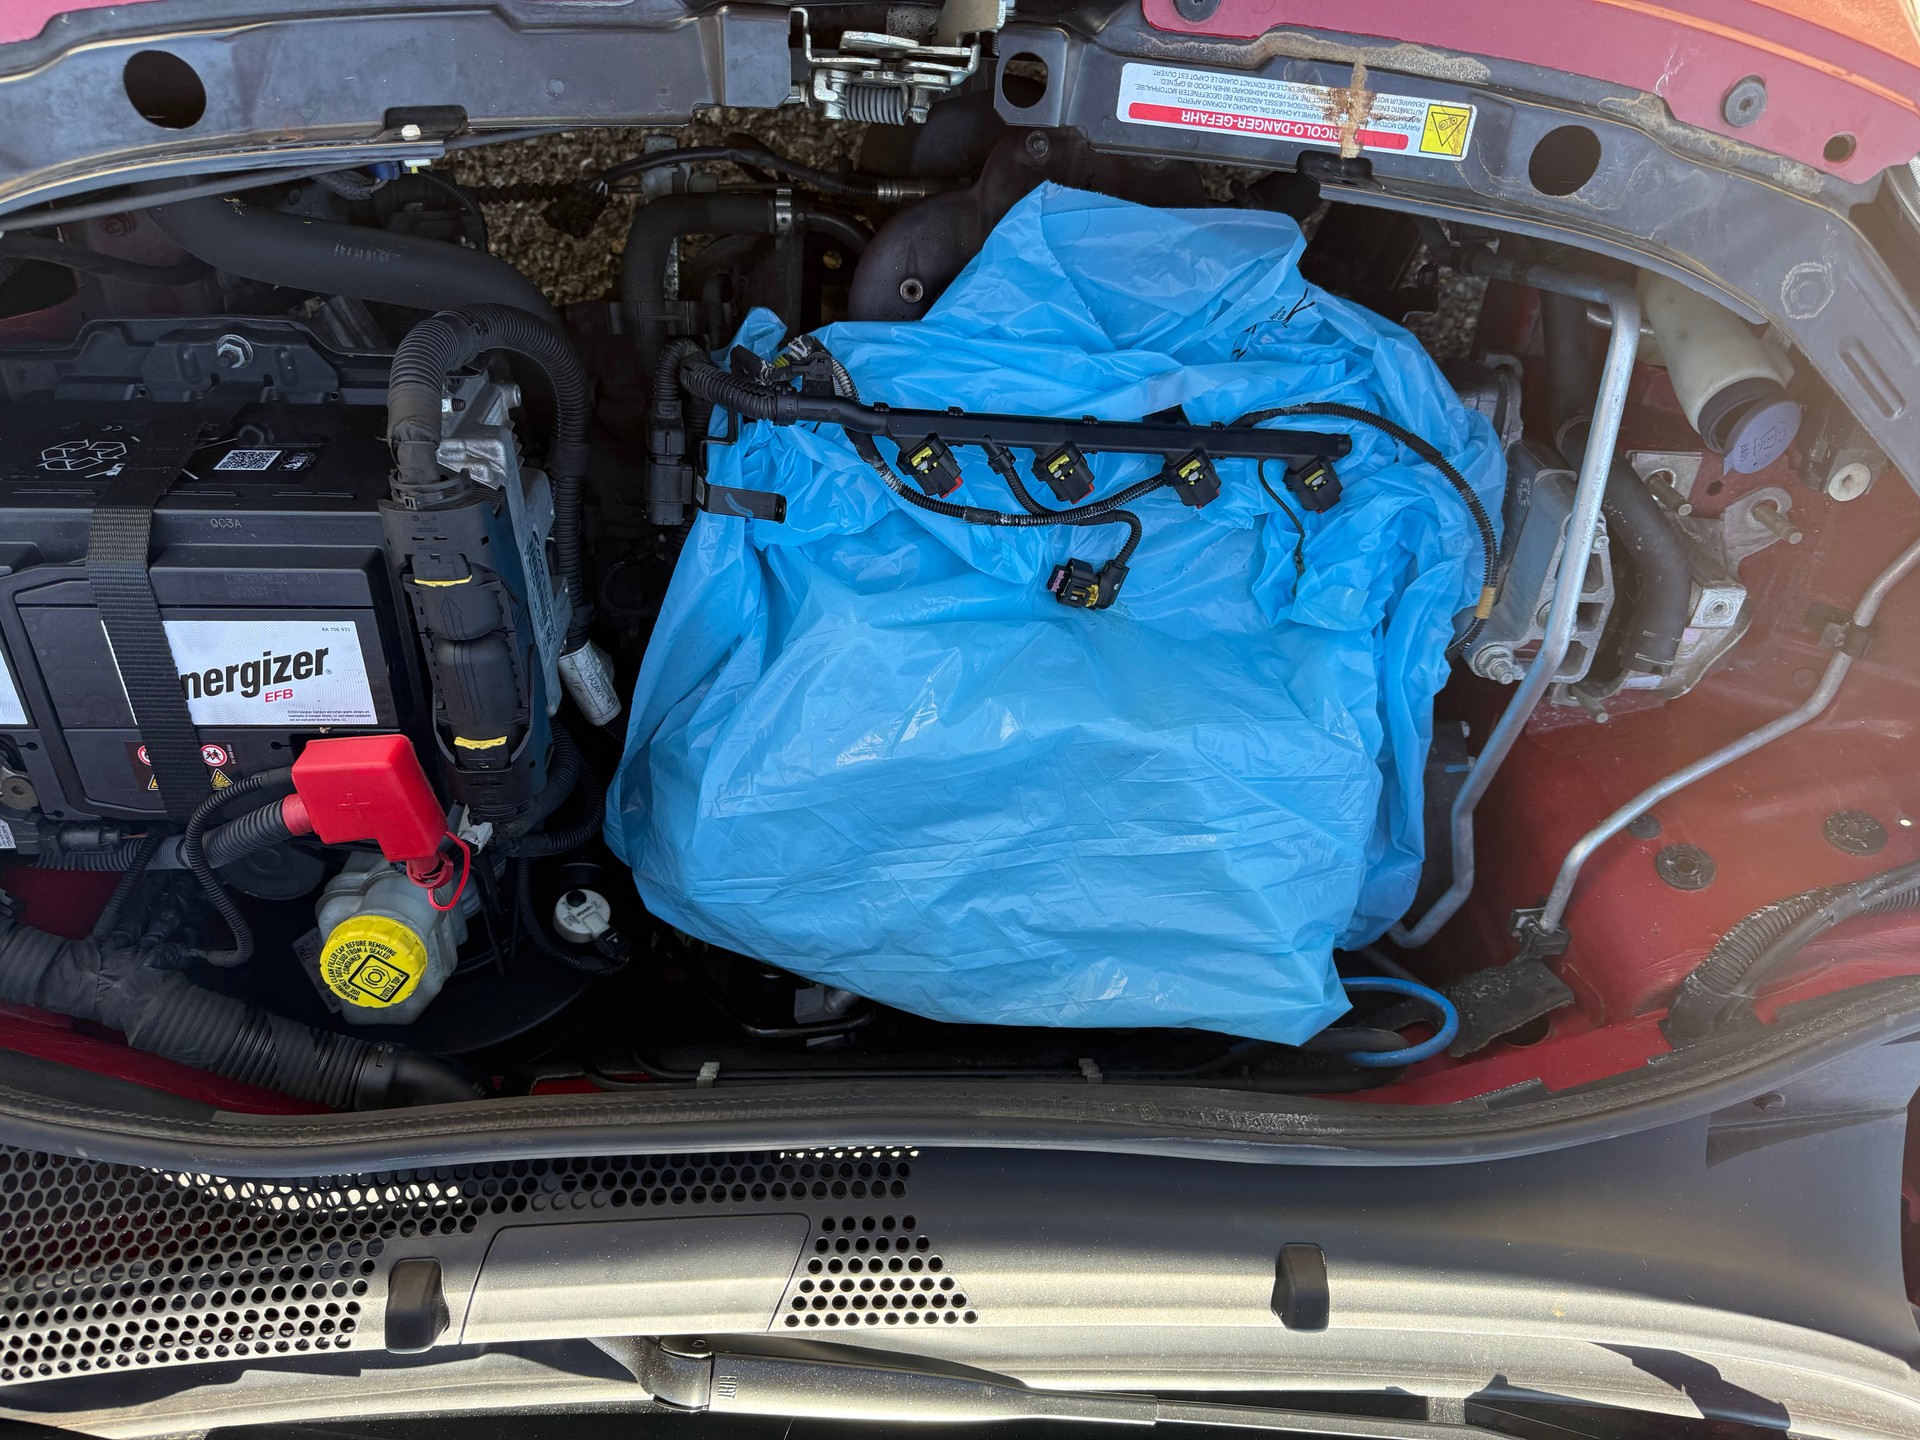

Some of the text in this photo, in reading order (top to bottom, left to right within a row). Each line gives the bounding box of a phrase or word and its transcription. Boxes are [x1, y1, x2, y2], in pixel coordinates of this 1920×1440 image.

[1180, 109, 1358, 142] RICOLO-DANGER-GEFAHR
[210, 518, 243, 529] QC3A
[180, 647, 329, 698] nergizer
[265, 688, 293, 703] EFB
[335, 945, 345, 954] CAP
[345, 940, 367, 949] BEFORE
[368, 940, 397, 957] REMOVING
[328, 952, 338, 968] FILLER
[346, 947, 362, 956] FROM
[369, 947, 391, 960] SEALED
[328, 968, 338, 983] CLEAN
[380, 981, 395, 999] TUTELA
